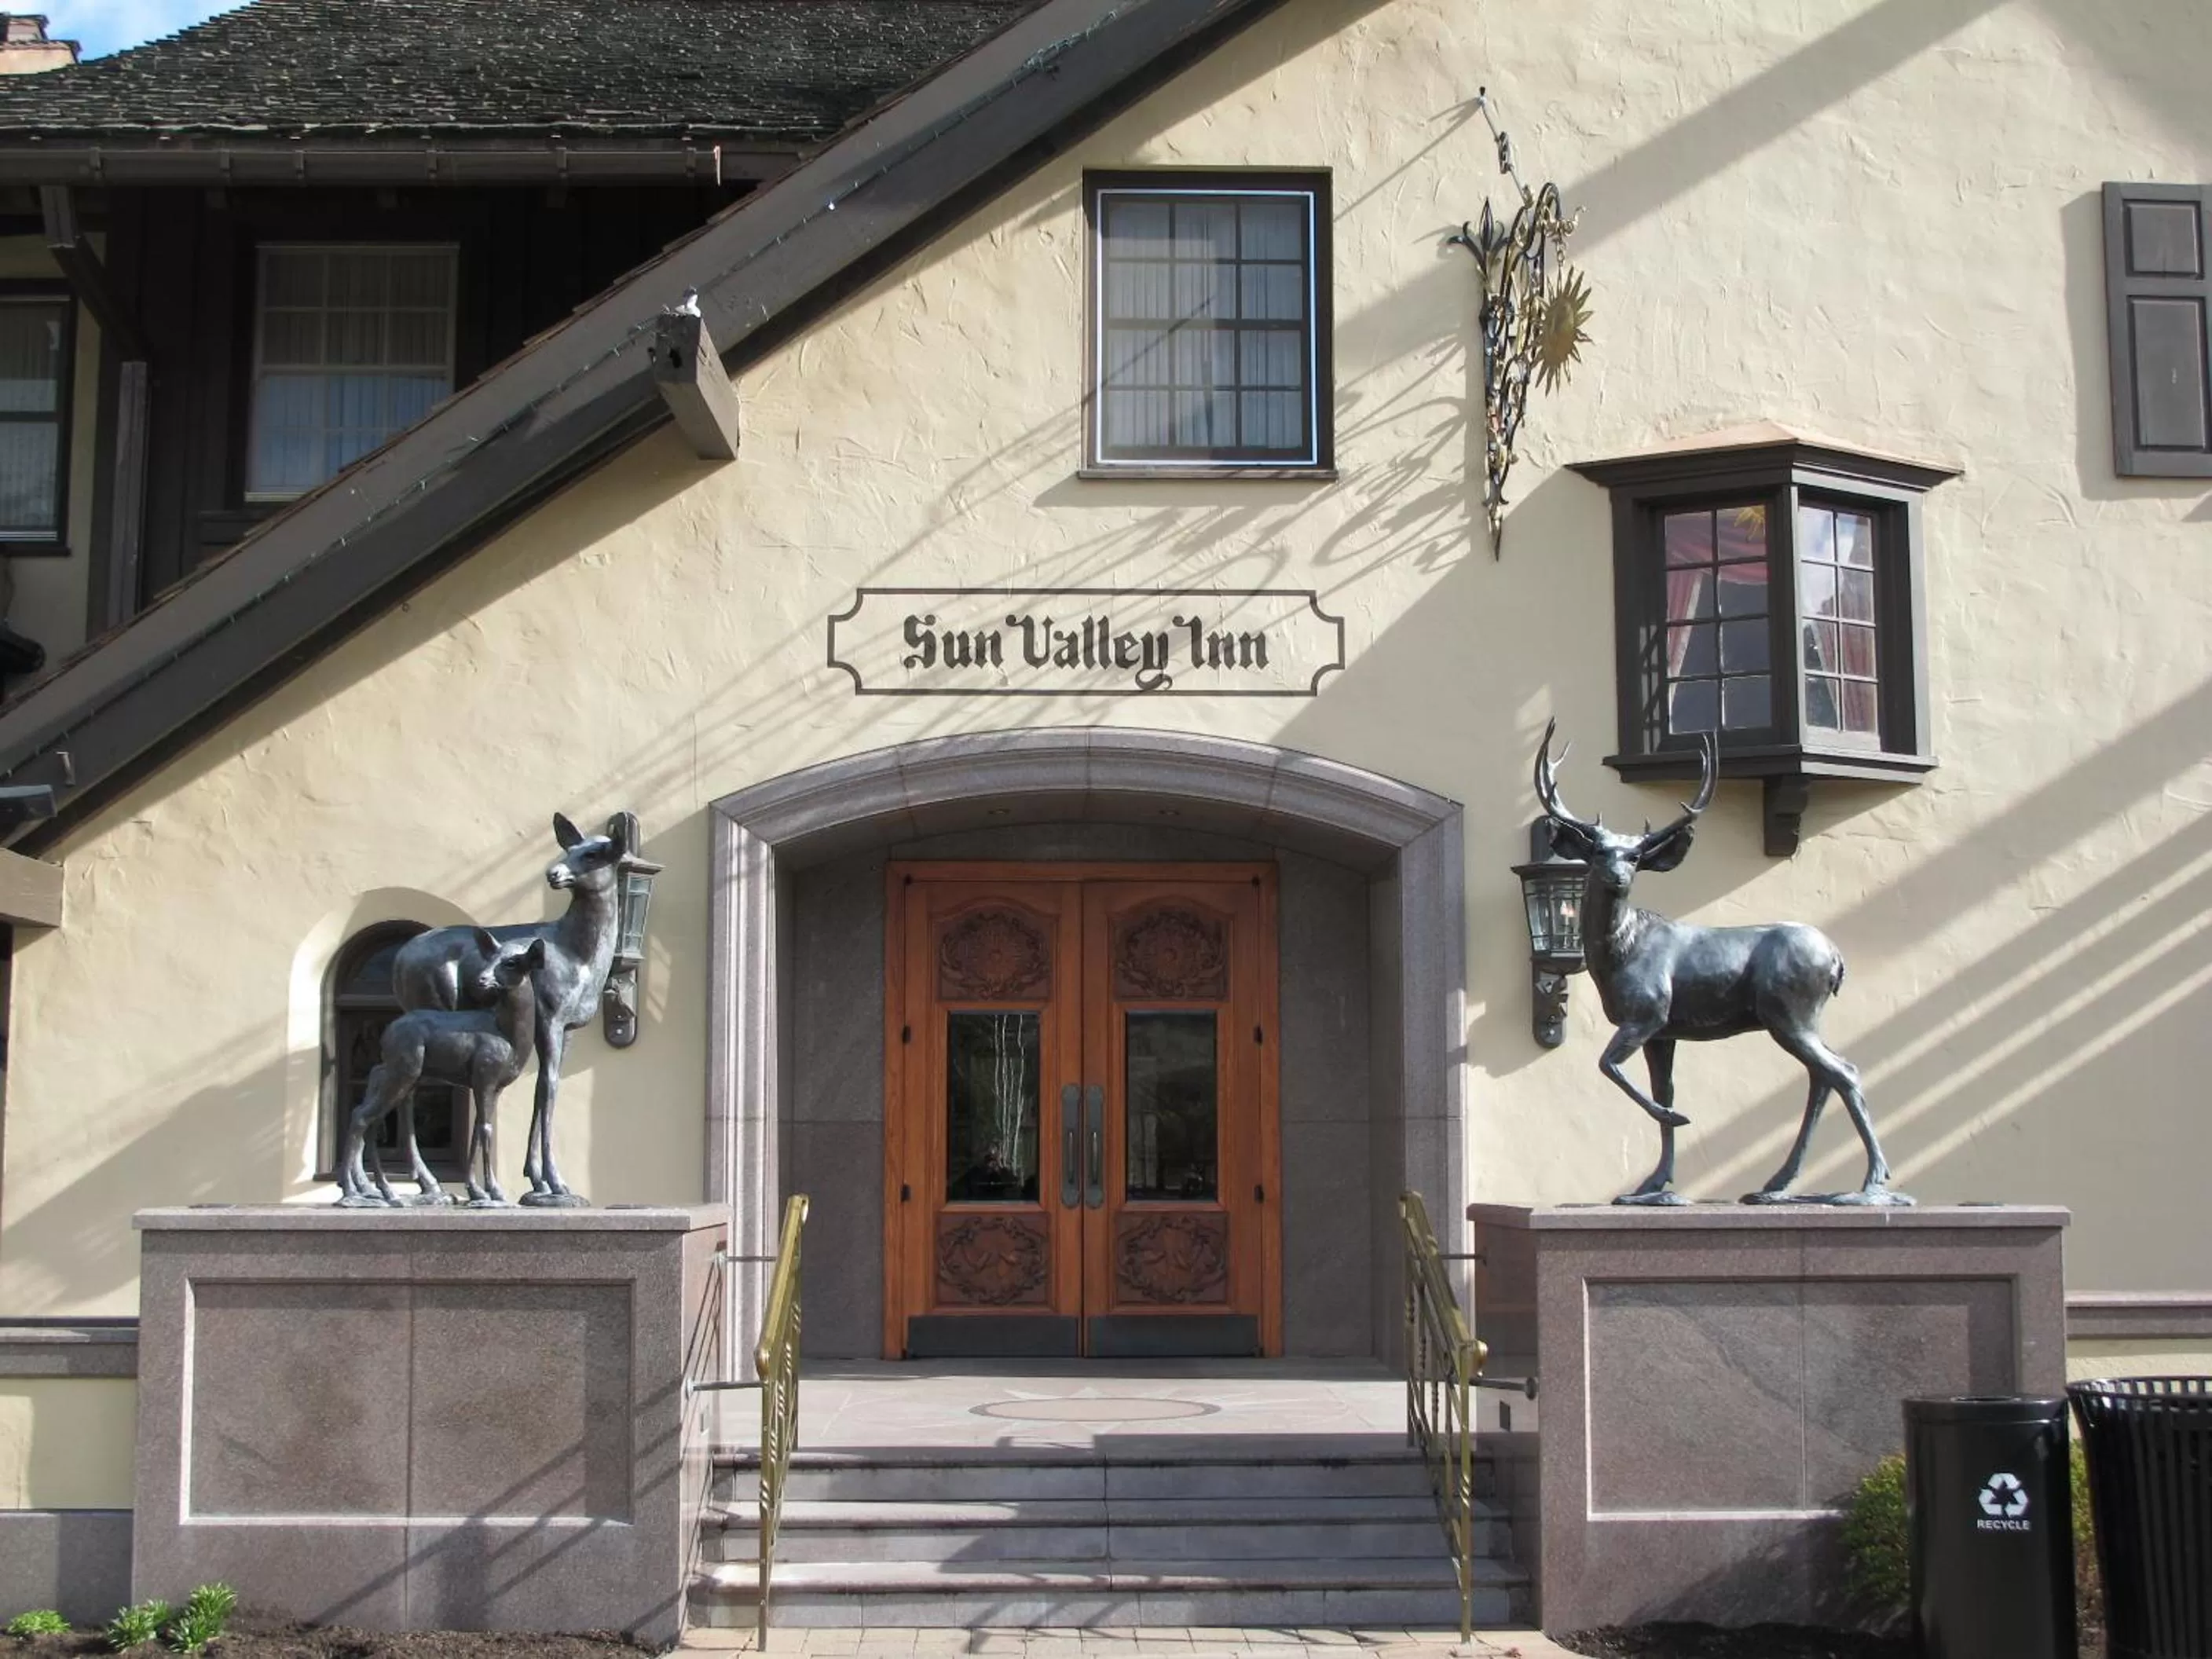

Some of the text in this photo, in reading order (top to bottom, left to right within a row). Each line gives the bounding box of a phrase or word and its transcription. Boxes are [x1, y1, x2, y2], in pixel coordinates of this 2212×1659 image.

[903, 614, 1269, 691] Sun Valley Inn
[1977, 1519, 2031, 1530] RECYCLE
